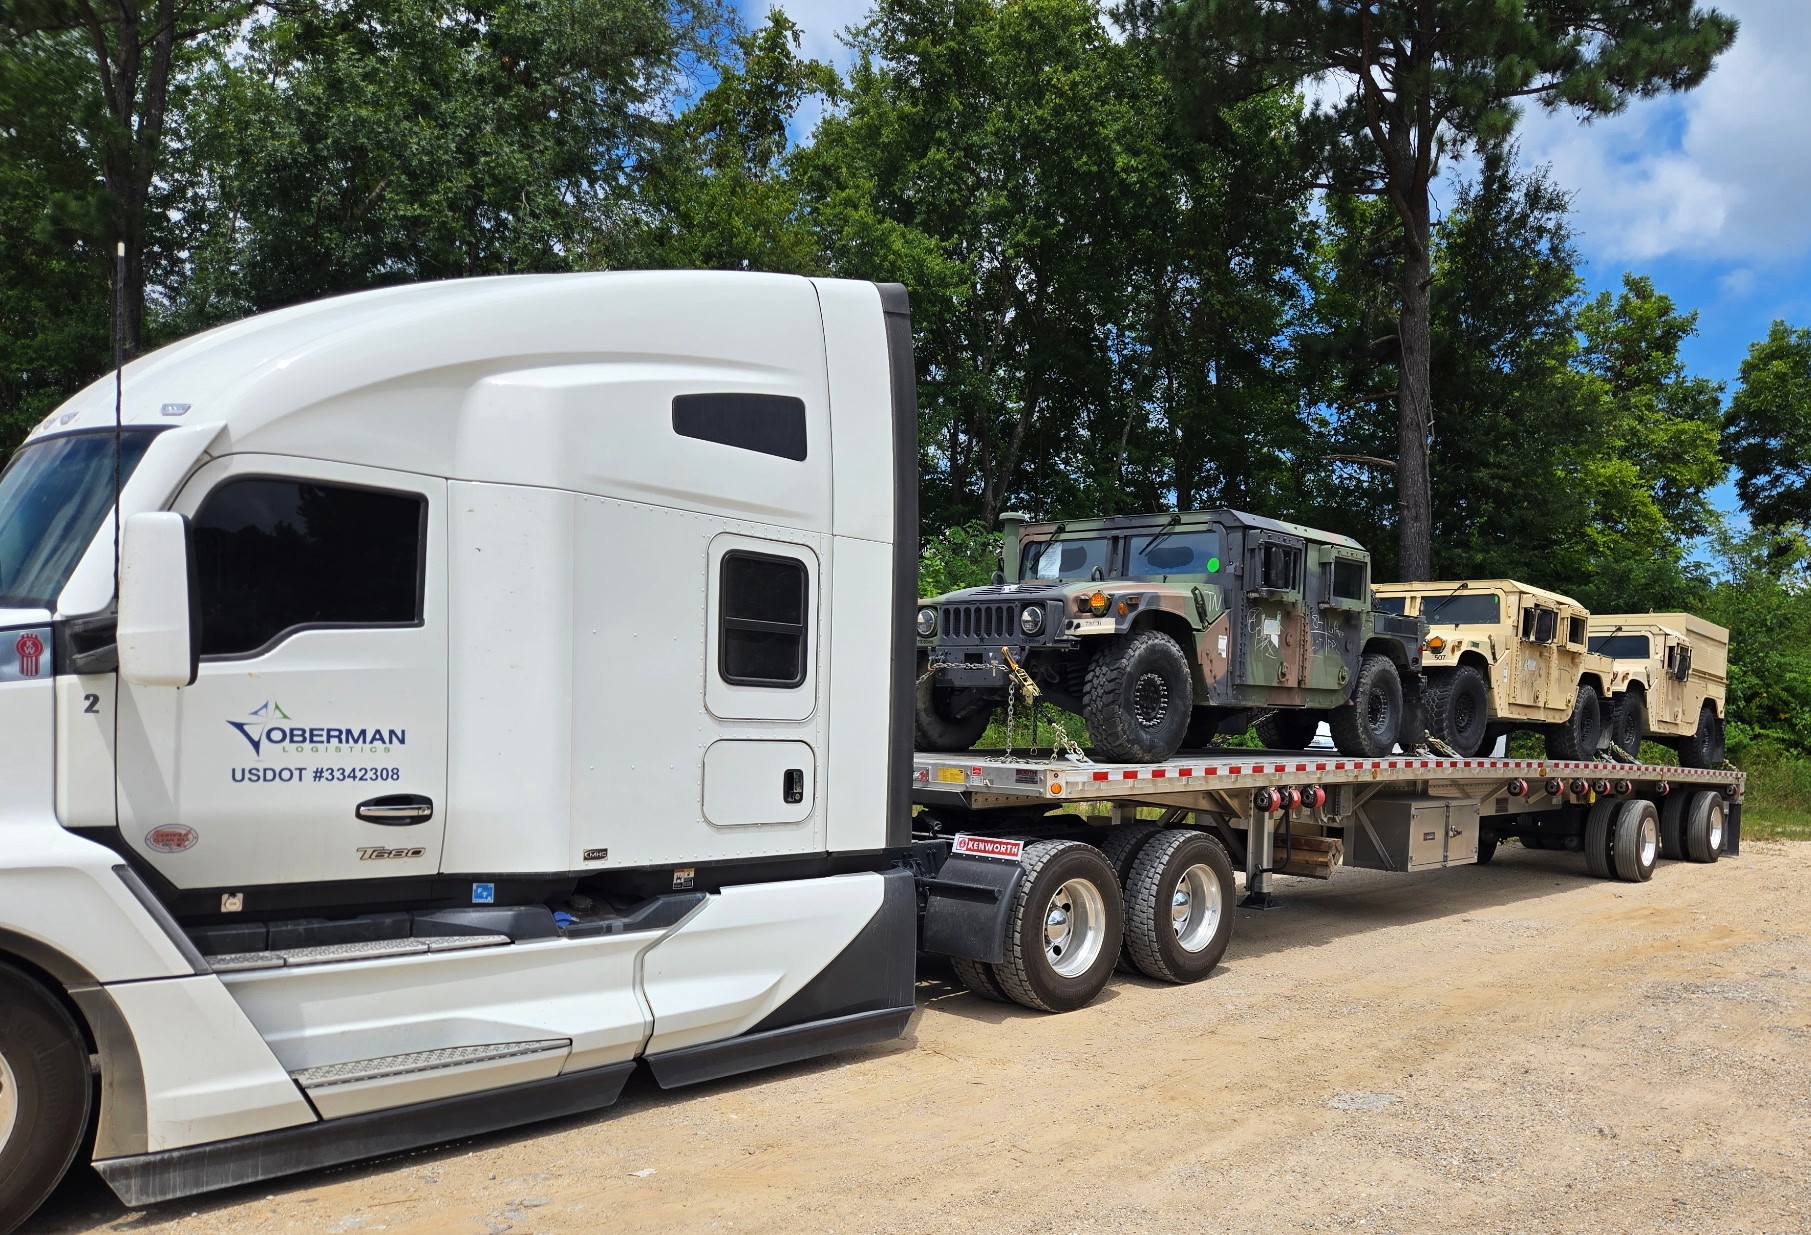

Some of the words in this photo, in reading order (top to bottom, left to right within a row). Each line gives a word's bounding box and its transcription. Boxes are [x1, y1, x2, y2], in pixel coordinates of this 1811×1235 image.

[83, 693, 100, 714] 2
[265, 727, 406, 745] OBERMAN
[282, 745, 391, 753] LOGISTICS
[231, 767, 307, 783] USDOT
[312, 767, 401, 782] #3342308
[356, 846, 427, 861] T680
[967, 841, 1019, 855] KENWORTH
